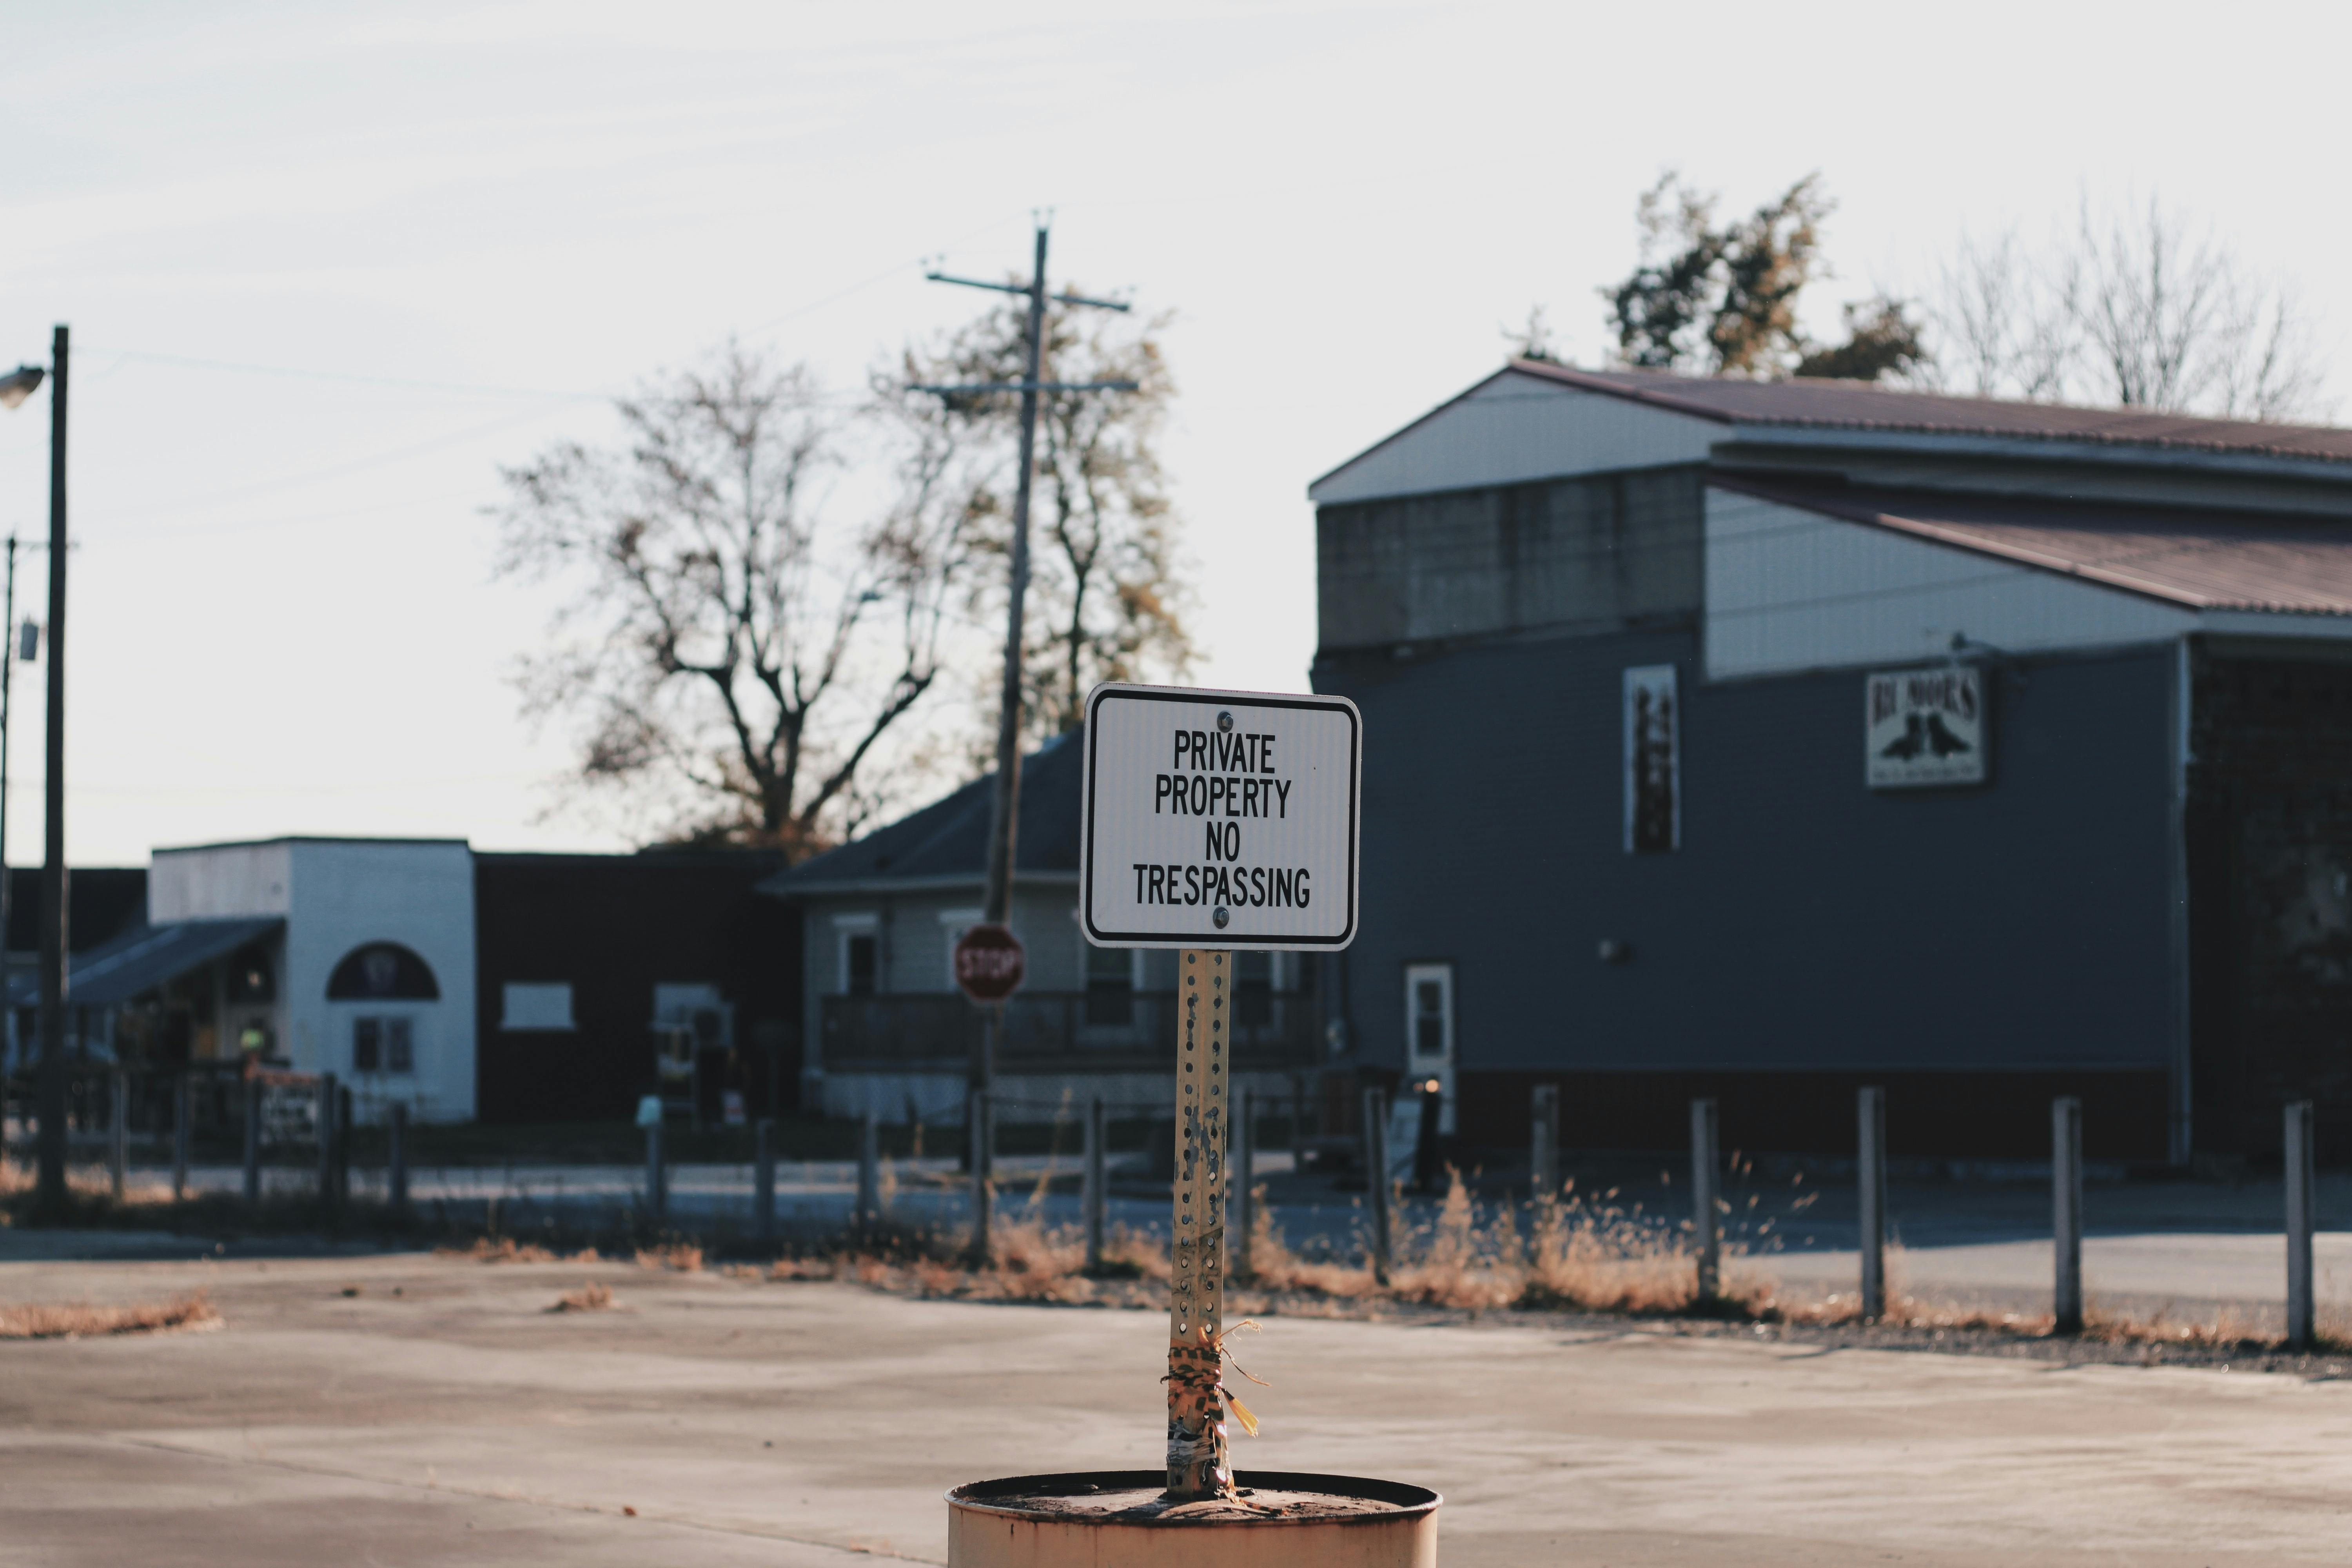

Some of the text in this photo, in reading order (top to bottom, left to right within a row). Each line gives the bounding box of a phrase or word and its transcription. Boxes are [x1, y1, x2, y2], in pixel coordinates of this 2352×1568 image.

[1174, 730, 1276, 774] PRIVATE
[1156, 774, 1292, 818] PROPERTY
[1206, 821, 1240, 862] NO
[1133, 864, 1310, 908] TRESPASSING
[962, 947, 1016, 979] STOP
